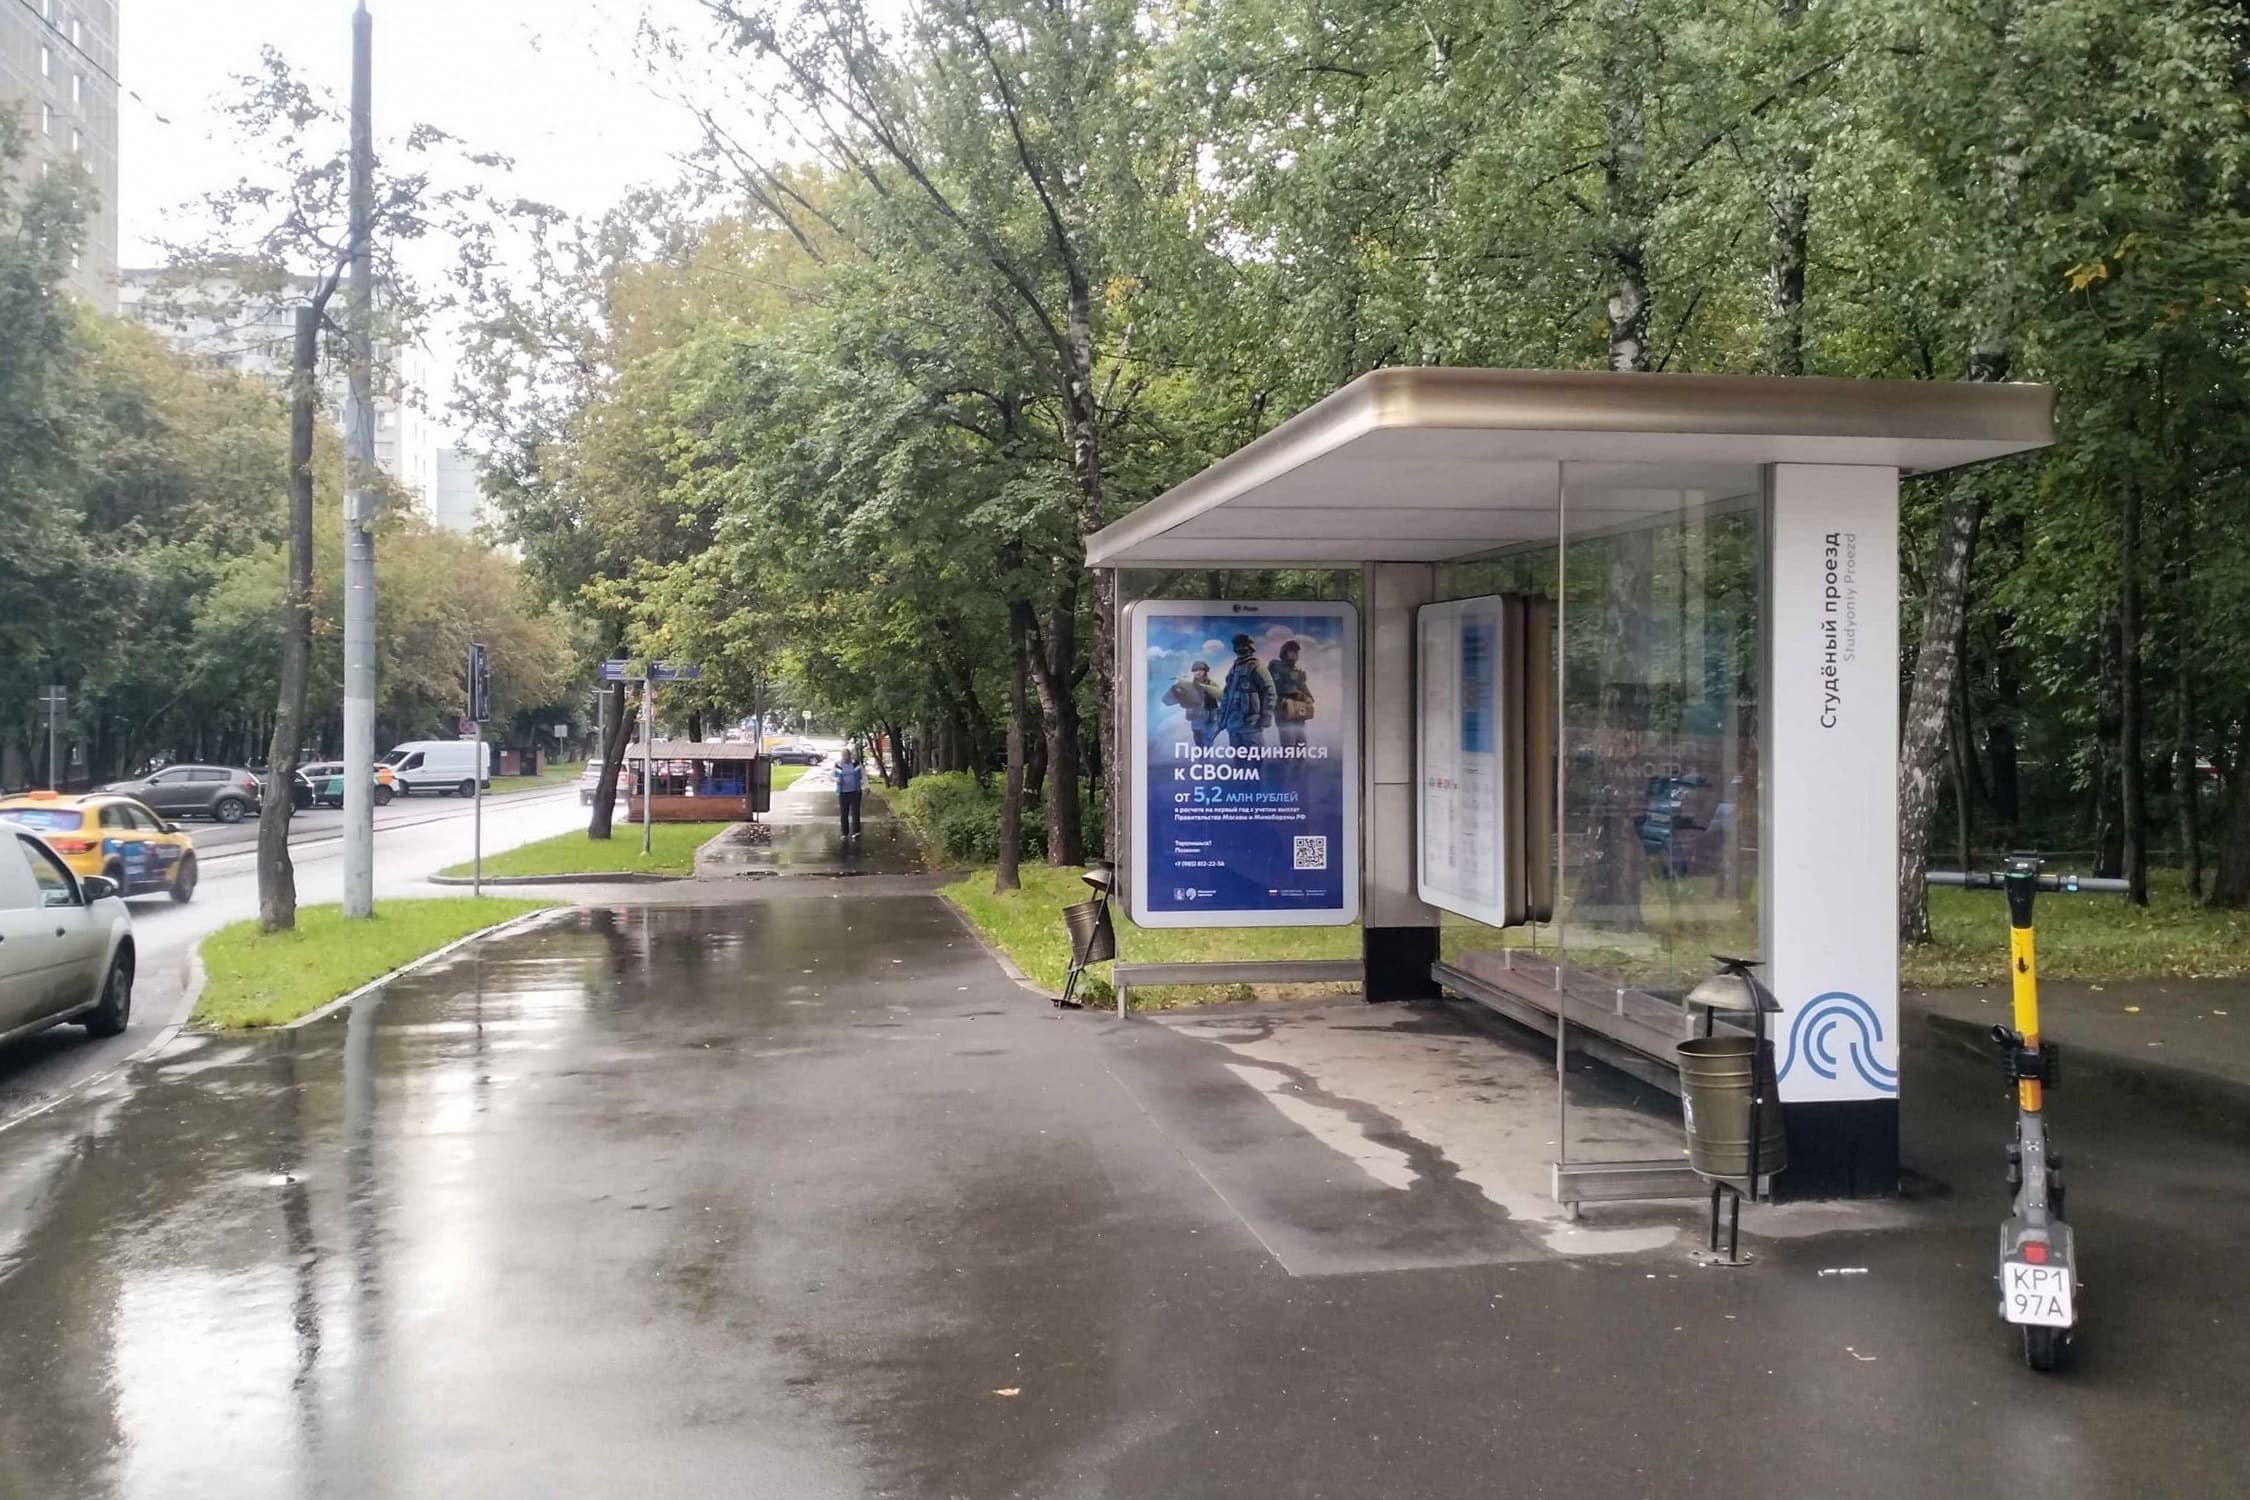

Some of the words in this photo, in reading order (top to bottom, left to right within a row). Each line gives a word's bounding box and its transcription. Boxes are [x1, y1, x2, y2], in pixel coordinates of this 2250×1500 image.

[1824, 532, 1842, 613] проезд
[1842, 532, 1856, 584] Proezd
[1842, 587, 1858, 663] Studyoniy
[1819, 619, 1841, 729] Студёный
[1174, 742, 1328, 762] Присоединяйся
[1174, 767, 1186, 781] к
[1189, 763, 1260, 781] СВОим
[1174, 793, 1191, 803] от
[1193, 786, 1223, 806] 5,2
[1255, 790, 1299, 803] РУБЛЕЙ
[2014, 1293, 2064, 1318] 97A
